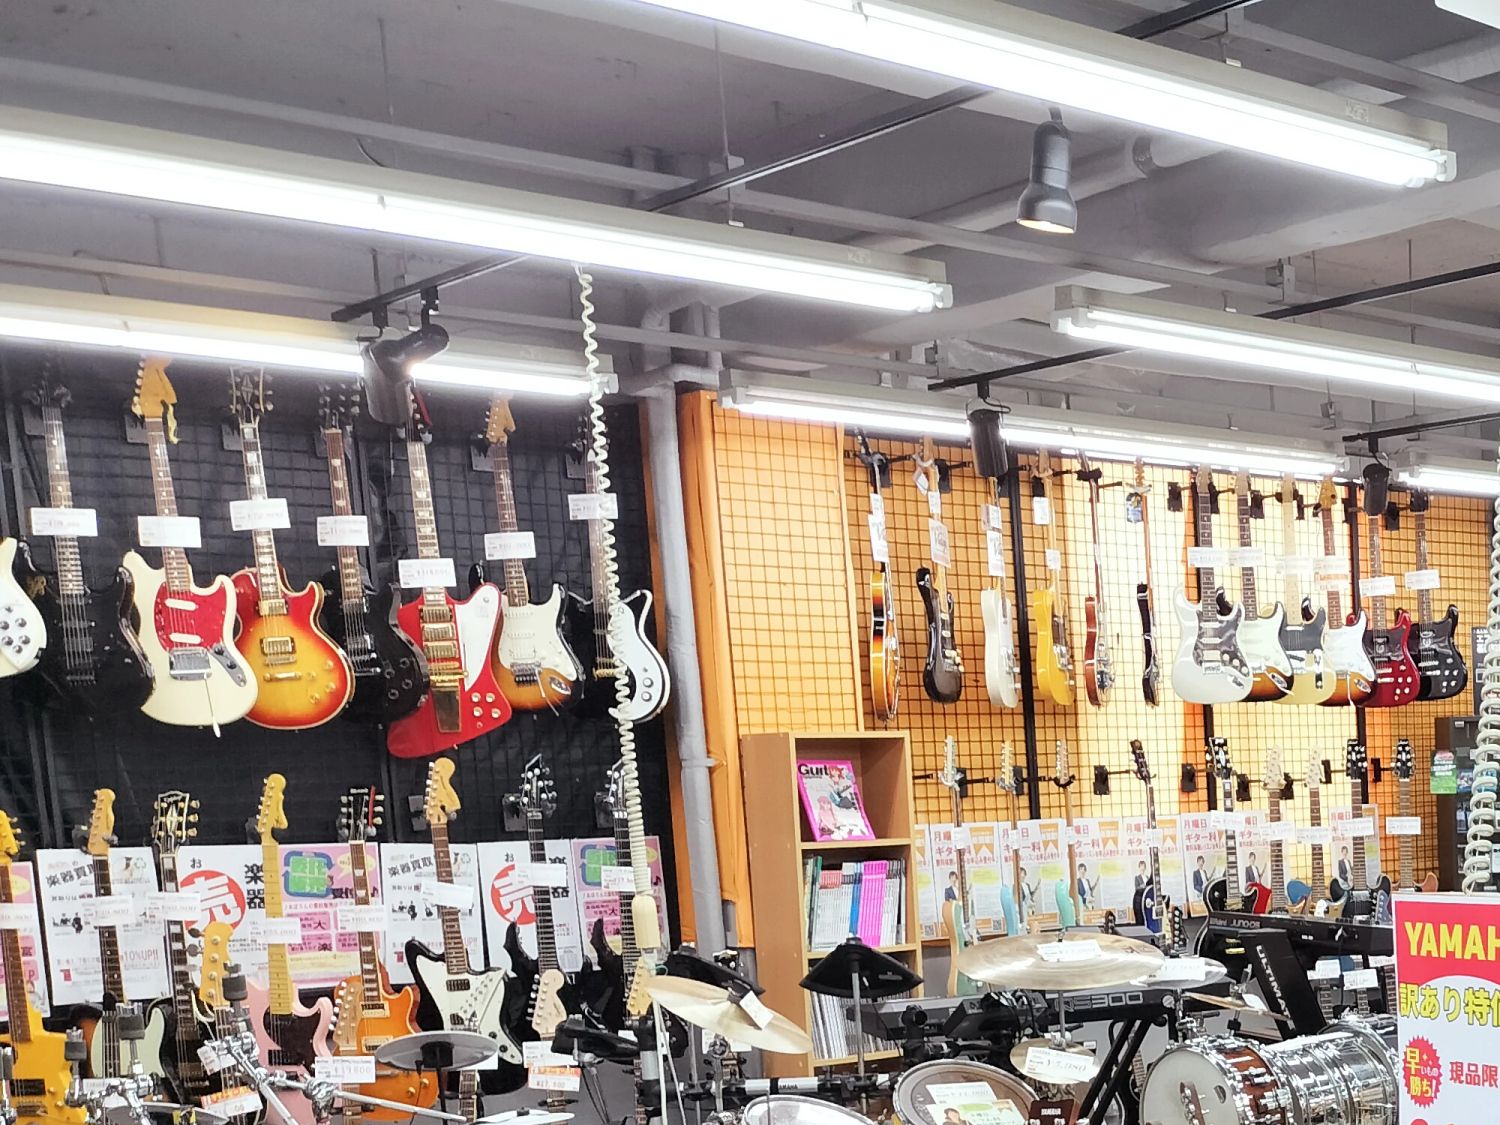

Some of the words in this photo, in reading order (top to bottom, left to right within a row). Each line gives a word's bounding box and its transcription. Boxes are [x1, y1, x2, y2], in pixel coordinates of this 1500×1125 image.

[798, 763, 829, 777] Guit
[1002, 827, 1029, 839] 月日
[504, 852, 514, 862] お
[190, 858, 202, 869] お
[388, 856, 433, 878] 楽器買取
